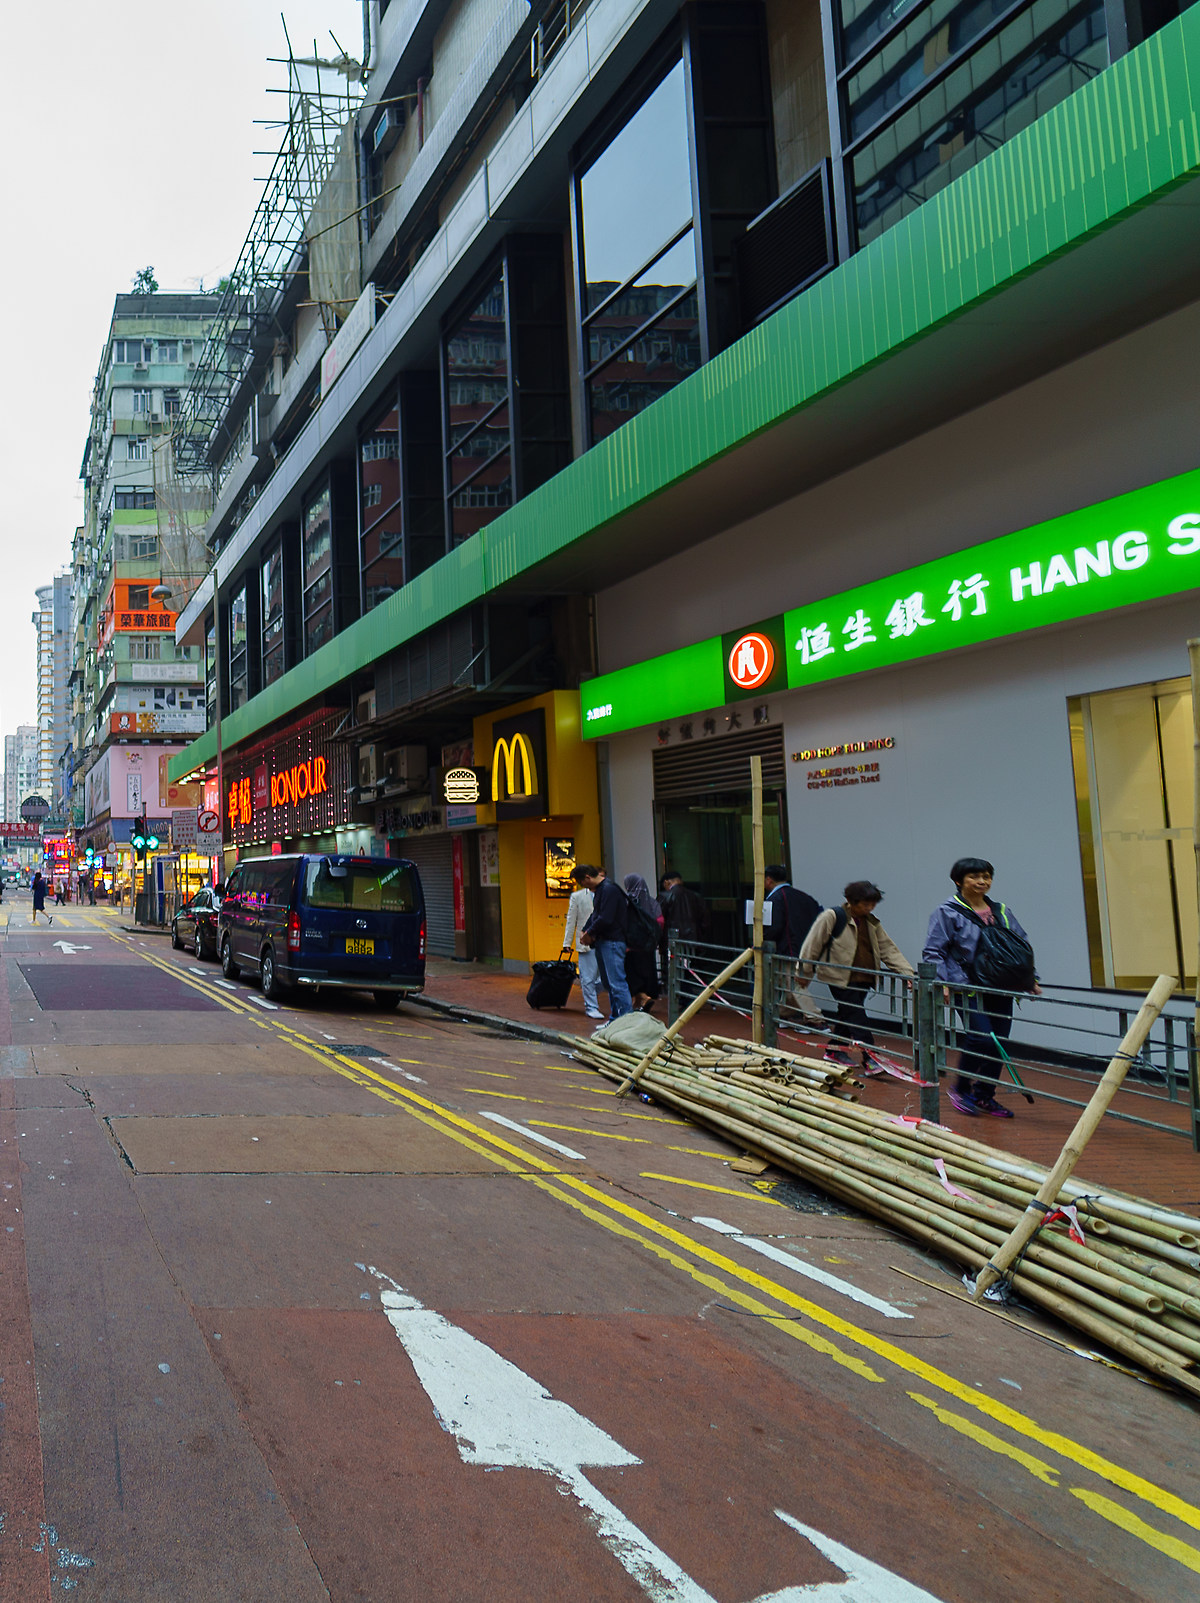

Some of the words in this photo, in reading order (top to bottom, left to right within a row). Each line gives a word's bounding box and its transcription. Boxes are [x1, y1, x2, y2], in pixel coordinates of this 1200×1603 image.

[794, 573, 989, 665] 恒生銀行
[1009, 530, 1149, 602] HANG
[817, 745, 842, 758] HOPE
[844, 737, 896, 754] BUILDING
[271, 756, 327, 807] BONJOUR
